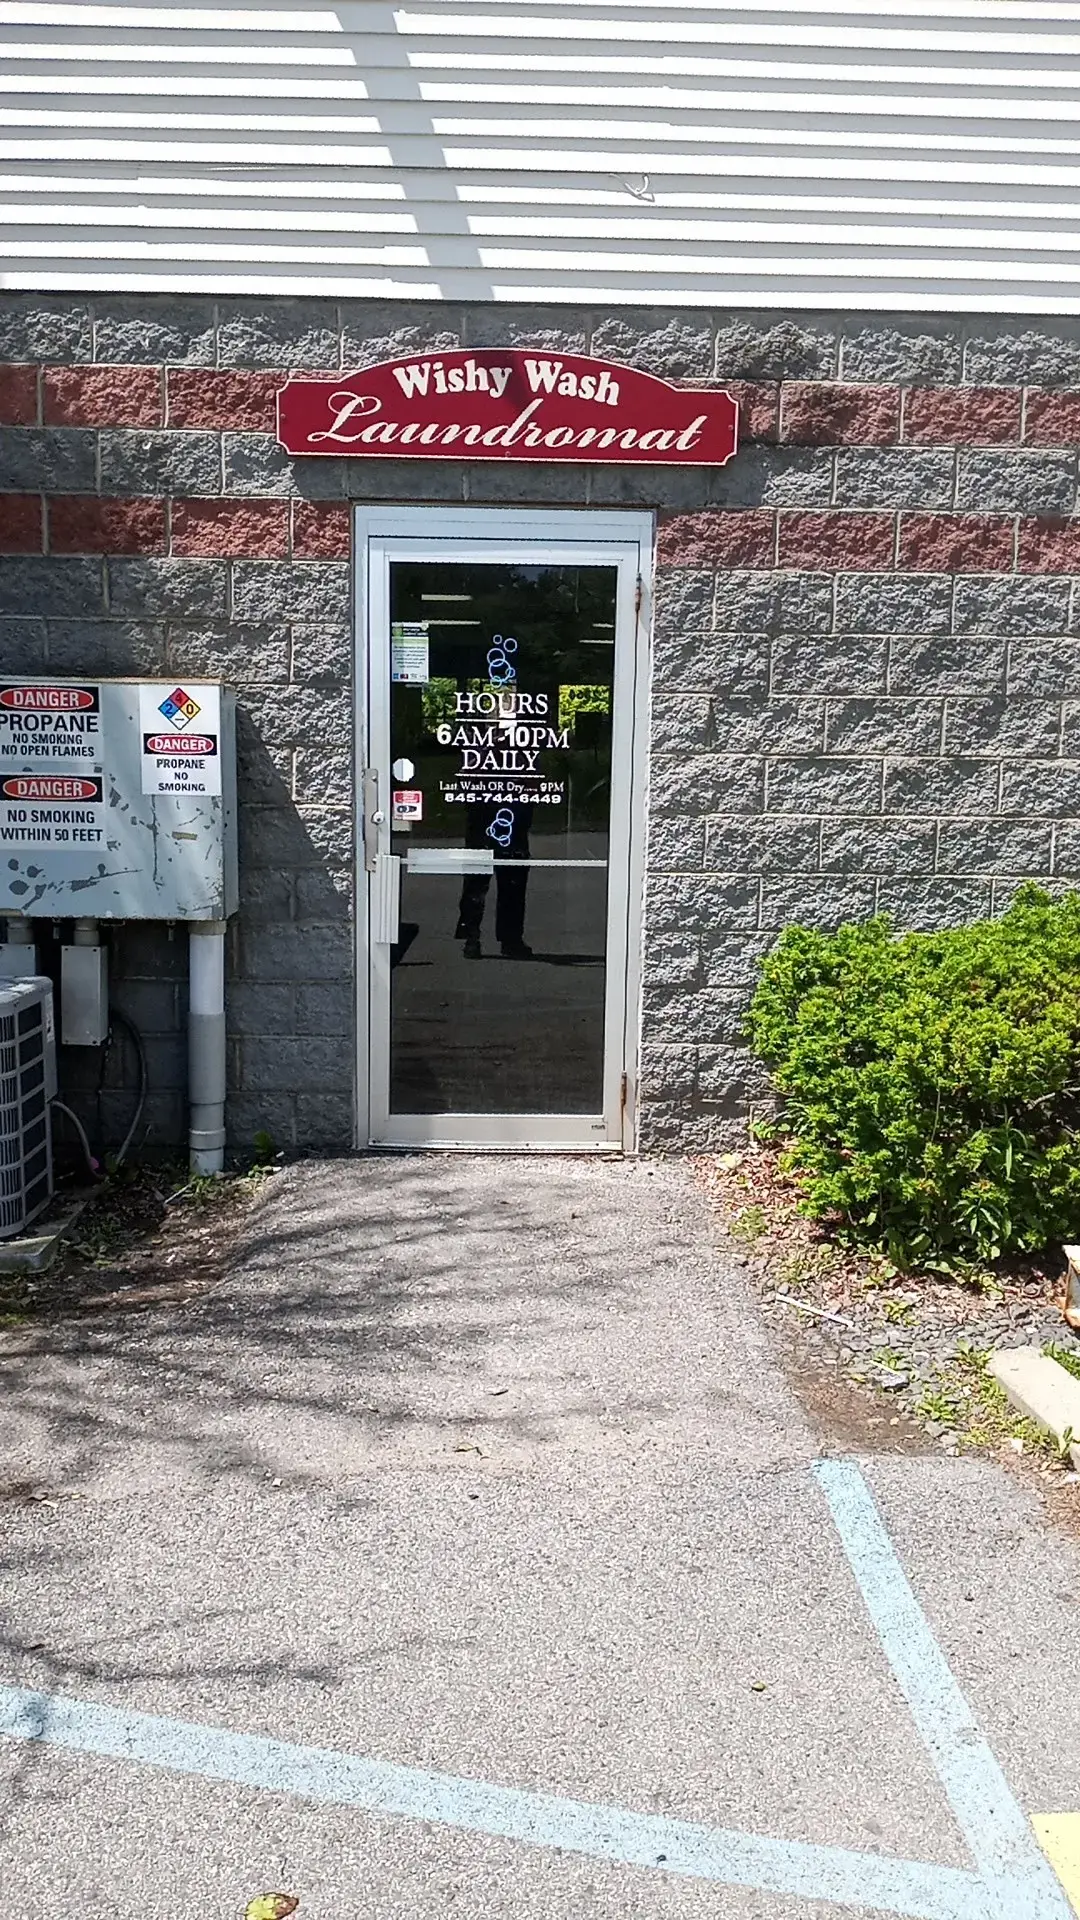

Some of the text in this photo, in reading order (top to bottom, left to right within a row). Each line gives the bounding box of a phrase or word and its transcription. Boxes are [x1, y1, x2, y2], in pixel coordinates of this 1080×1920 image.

[392, 358, 620, 406] Wishy Wash
[307, 391, 708, 452] Laundromat
[13, 690, 80, 707] DANGER
[454, 691, 549, 715] HOURS
[164, 703, 194, 715] 2 0
[0, 713, 99, 732] PROPANE
[12, 733, 83, 745] NO SMOKING
[154, 738, 207, 751] DANGER
[1, 744, 95, 757] NO OPEN FLAMES
[156, 758, 206, 769] PROPANE
[461, 749, 540, 771] DAILY
[174, 772, 189, 780] NO
[17, 781, 83, 797] DANGER
[158, 782, 206, 792] SMOKING
[439, 781, 458, 791] Last
[460, 781, 486, 791] Wash
[488, 781, 504, 791] OR
[7, 809, 95, 823] NO SMOKING
[0, 827, 103, 841] WITHIN 50 FEET
